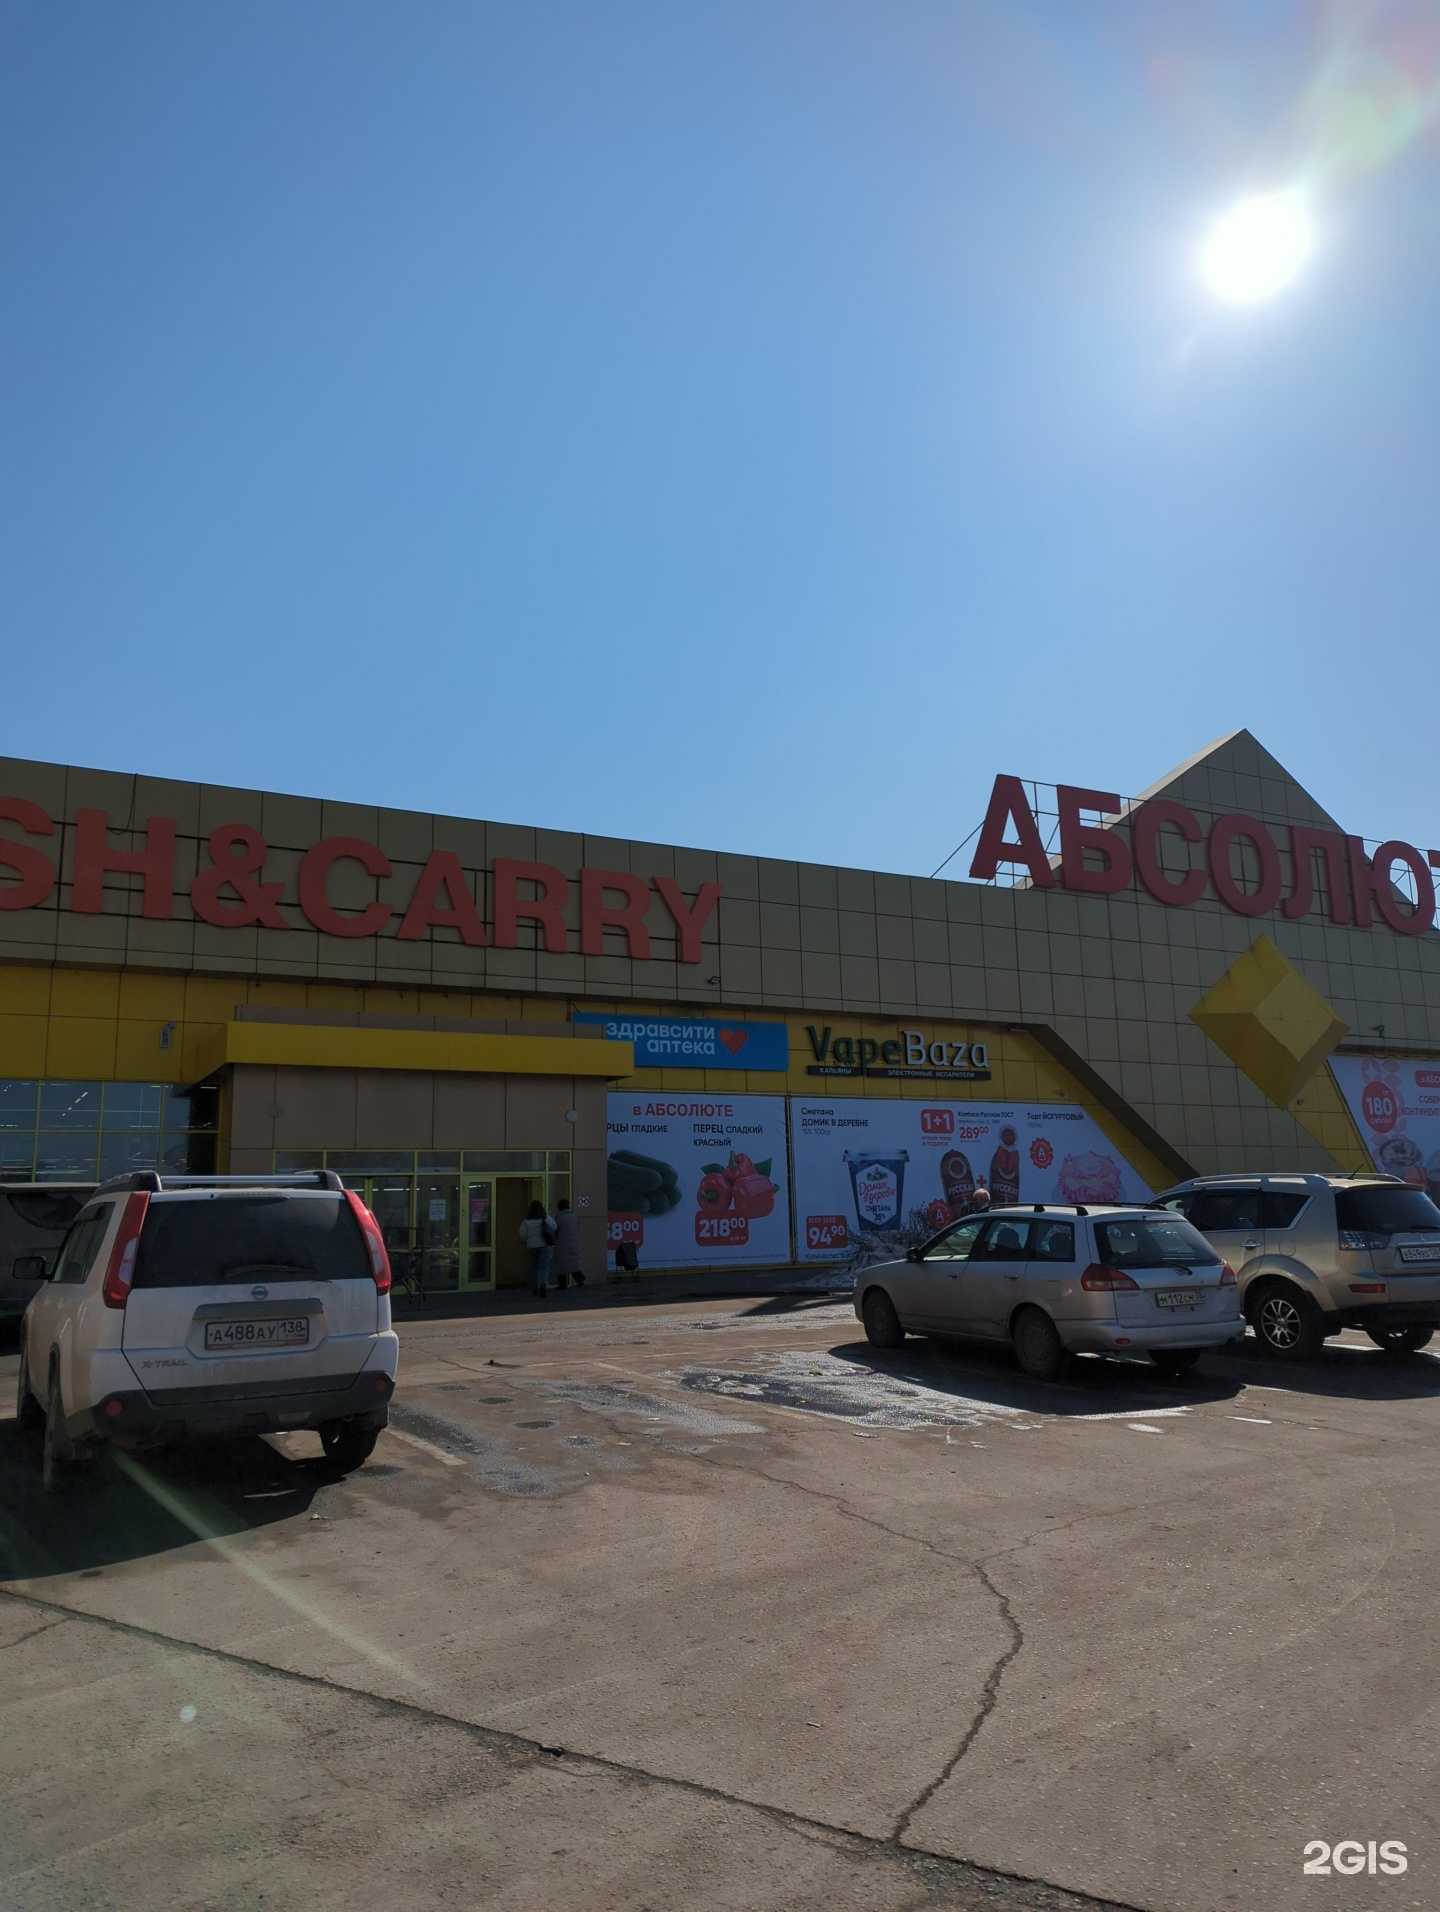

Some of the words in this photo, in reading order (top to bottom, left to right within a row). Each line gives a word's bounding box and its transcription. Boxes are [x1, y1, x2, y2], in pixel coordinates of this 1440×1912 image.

[969, 773, 1440, 936] АБСОЛЮ
[606, 1022, 715, 1041] здравсити
[647, 1039, 716, 1056] аптека
[645, 1103, 734, 1118] АБСОЛЮТЕ
[631, 1123, 669, 1134] ГЛАДКИЕ
[693, 1123, 724, 1135] ПЕРЕЦ
[725, 1124, 764, 1135] СЛАДКИЙ
[801, 1118, 830, 1128] ДОМИК
[838, 1119, 869, 1128] ДЕРЕВНЕ
[693, 1136, 732, 1147] КРАСНЫЙ
